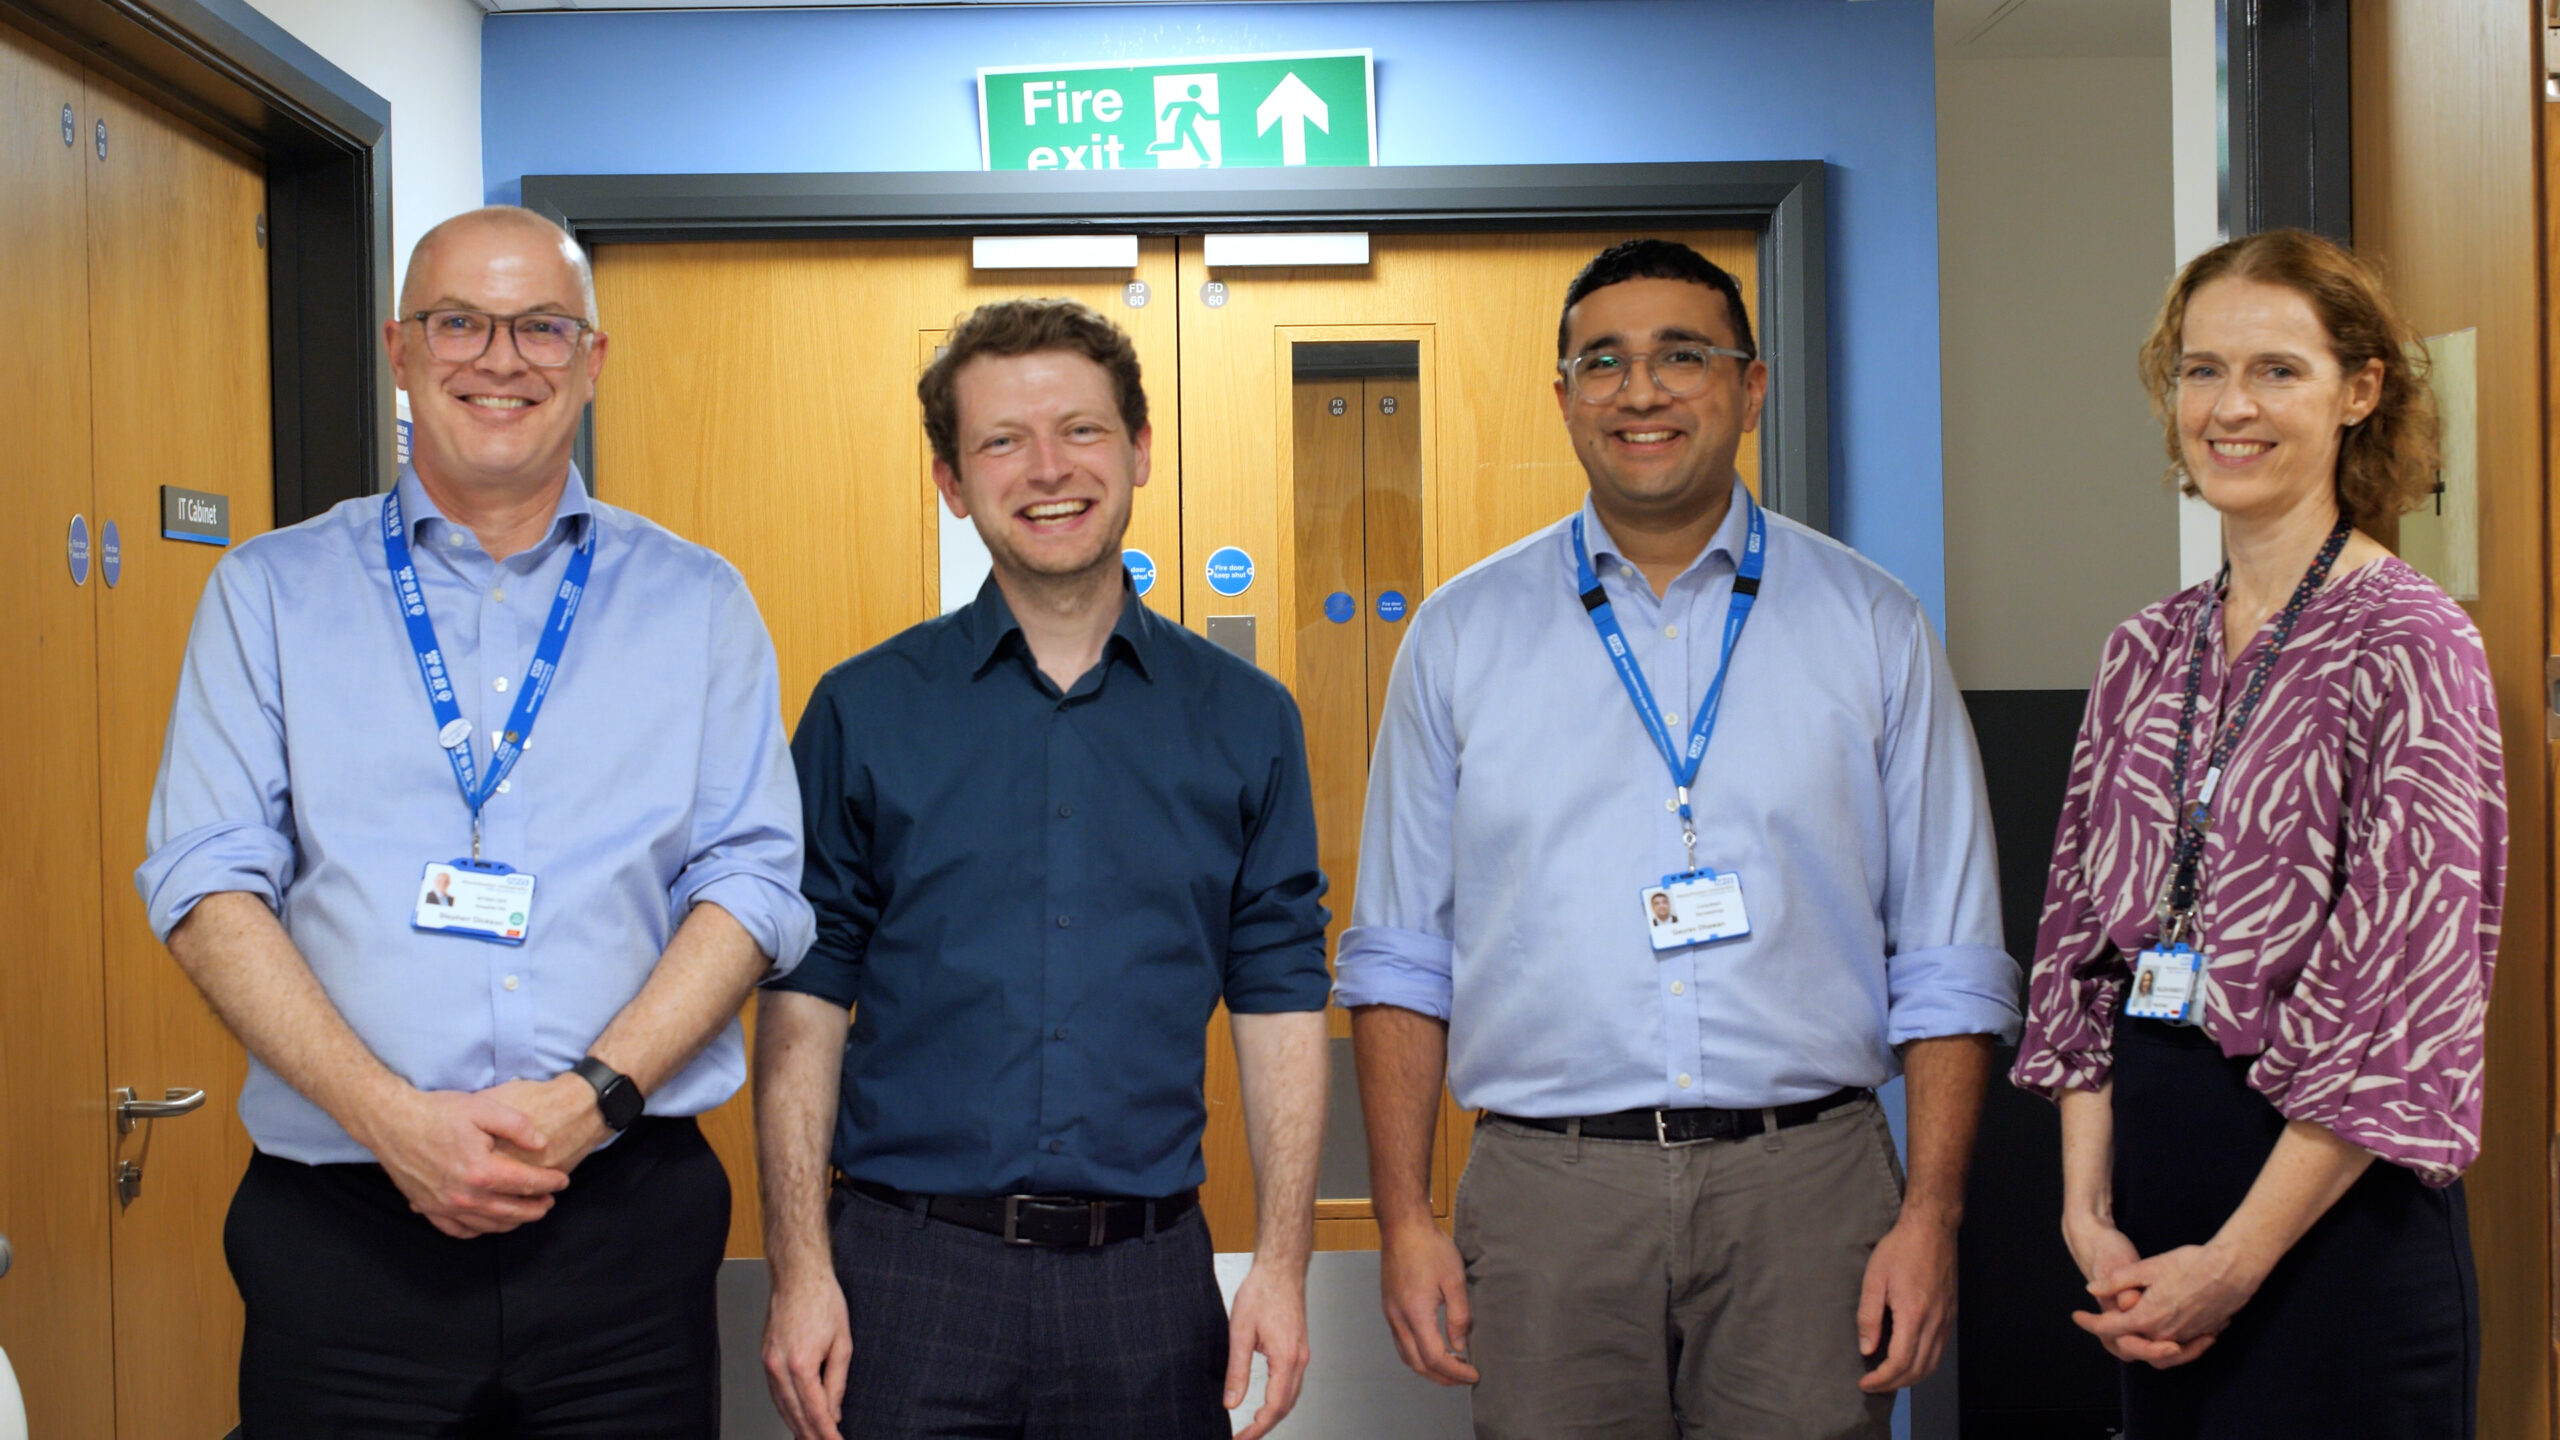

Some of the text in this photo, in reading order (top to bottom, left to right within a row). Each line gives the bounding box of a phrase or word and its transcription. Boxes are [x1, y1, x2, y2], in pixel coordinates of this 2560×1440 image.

[1023, 80, 1124, 126] Fire
[64, 108, 73, 123] FD
[1027, 133, 1125, 171] exit
[1128, 283, 1145, 293] FD
[1207, 283, 1224, 293] FD
[1129, 296, 1145, 306] 60
[1208, 296, 1224, 306] 60
[178, 497, 218, 525] IT Cabinet
[1608, 634, 1626, 656] NHS
[1688, 734, 1706, 759] NHS
